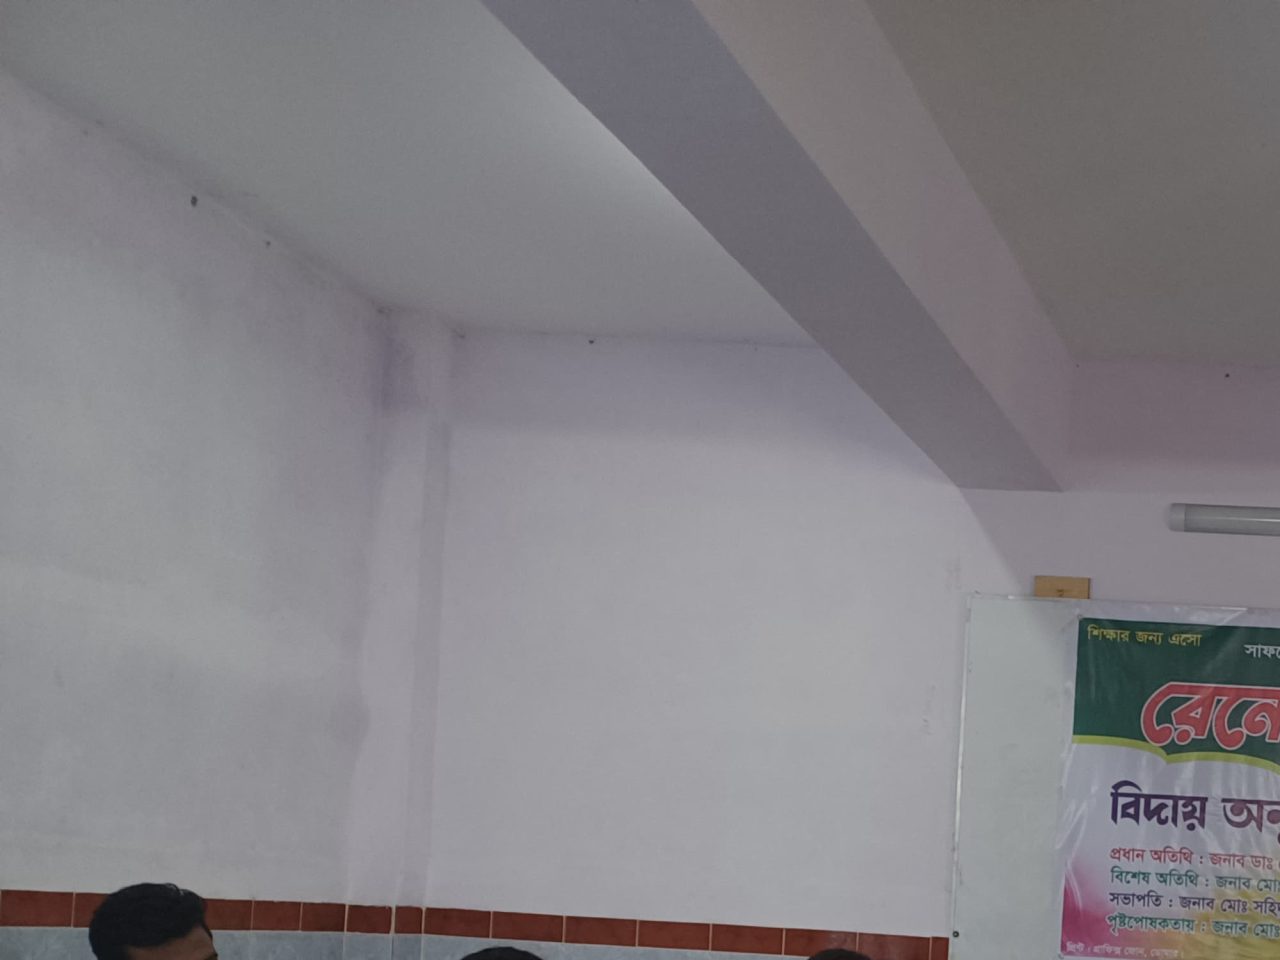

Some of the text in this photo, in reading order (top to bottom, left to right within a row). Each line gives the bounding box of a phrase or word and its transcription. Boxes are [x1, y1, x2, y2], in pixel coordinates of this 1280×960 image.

[1087, 625, 1202, 647] শিক্ষার জন্য এসো
[1111, 779, 1208, 831] বিদায়
[1109, 847, 1145, 865] প্রধান
[1151, 847, 1193, 866] অতিথি
[1209, 853, 1245, 868] জনাব
[1251, 854, 1273, 870] ডাঃ
[1111, 866, 1150, 885] বিশেষ
[1155, 867, 1198, 887] অতিথি
[1215, 875, 1251, 890] জনাব
[1109, 890, 1162, 908] সভাপতি
[1179, 897, 1215, 912] জনাব
[1220, 899, 1247, 914] মোঃ
[1211, 920, 1247, 936] জনাব
[1253, 922, 1280, 938] মোঃ
